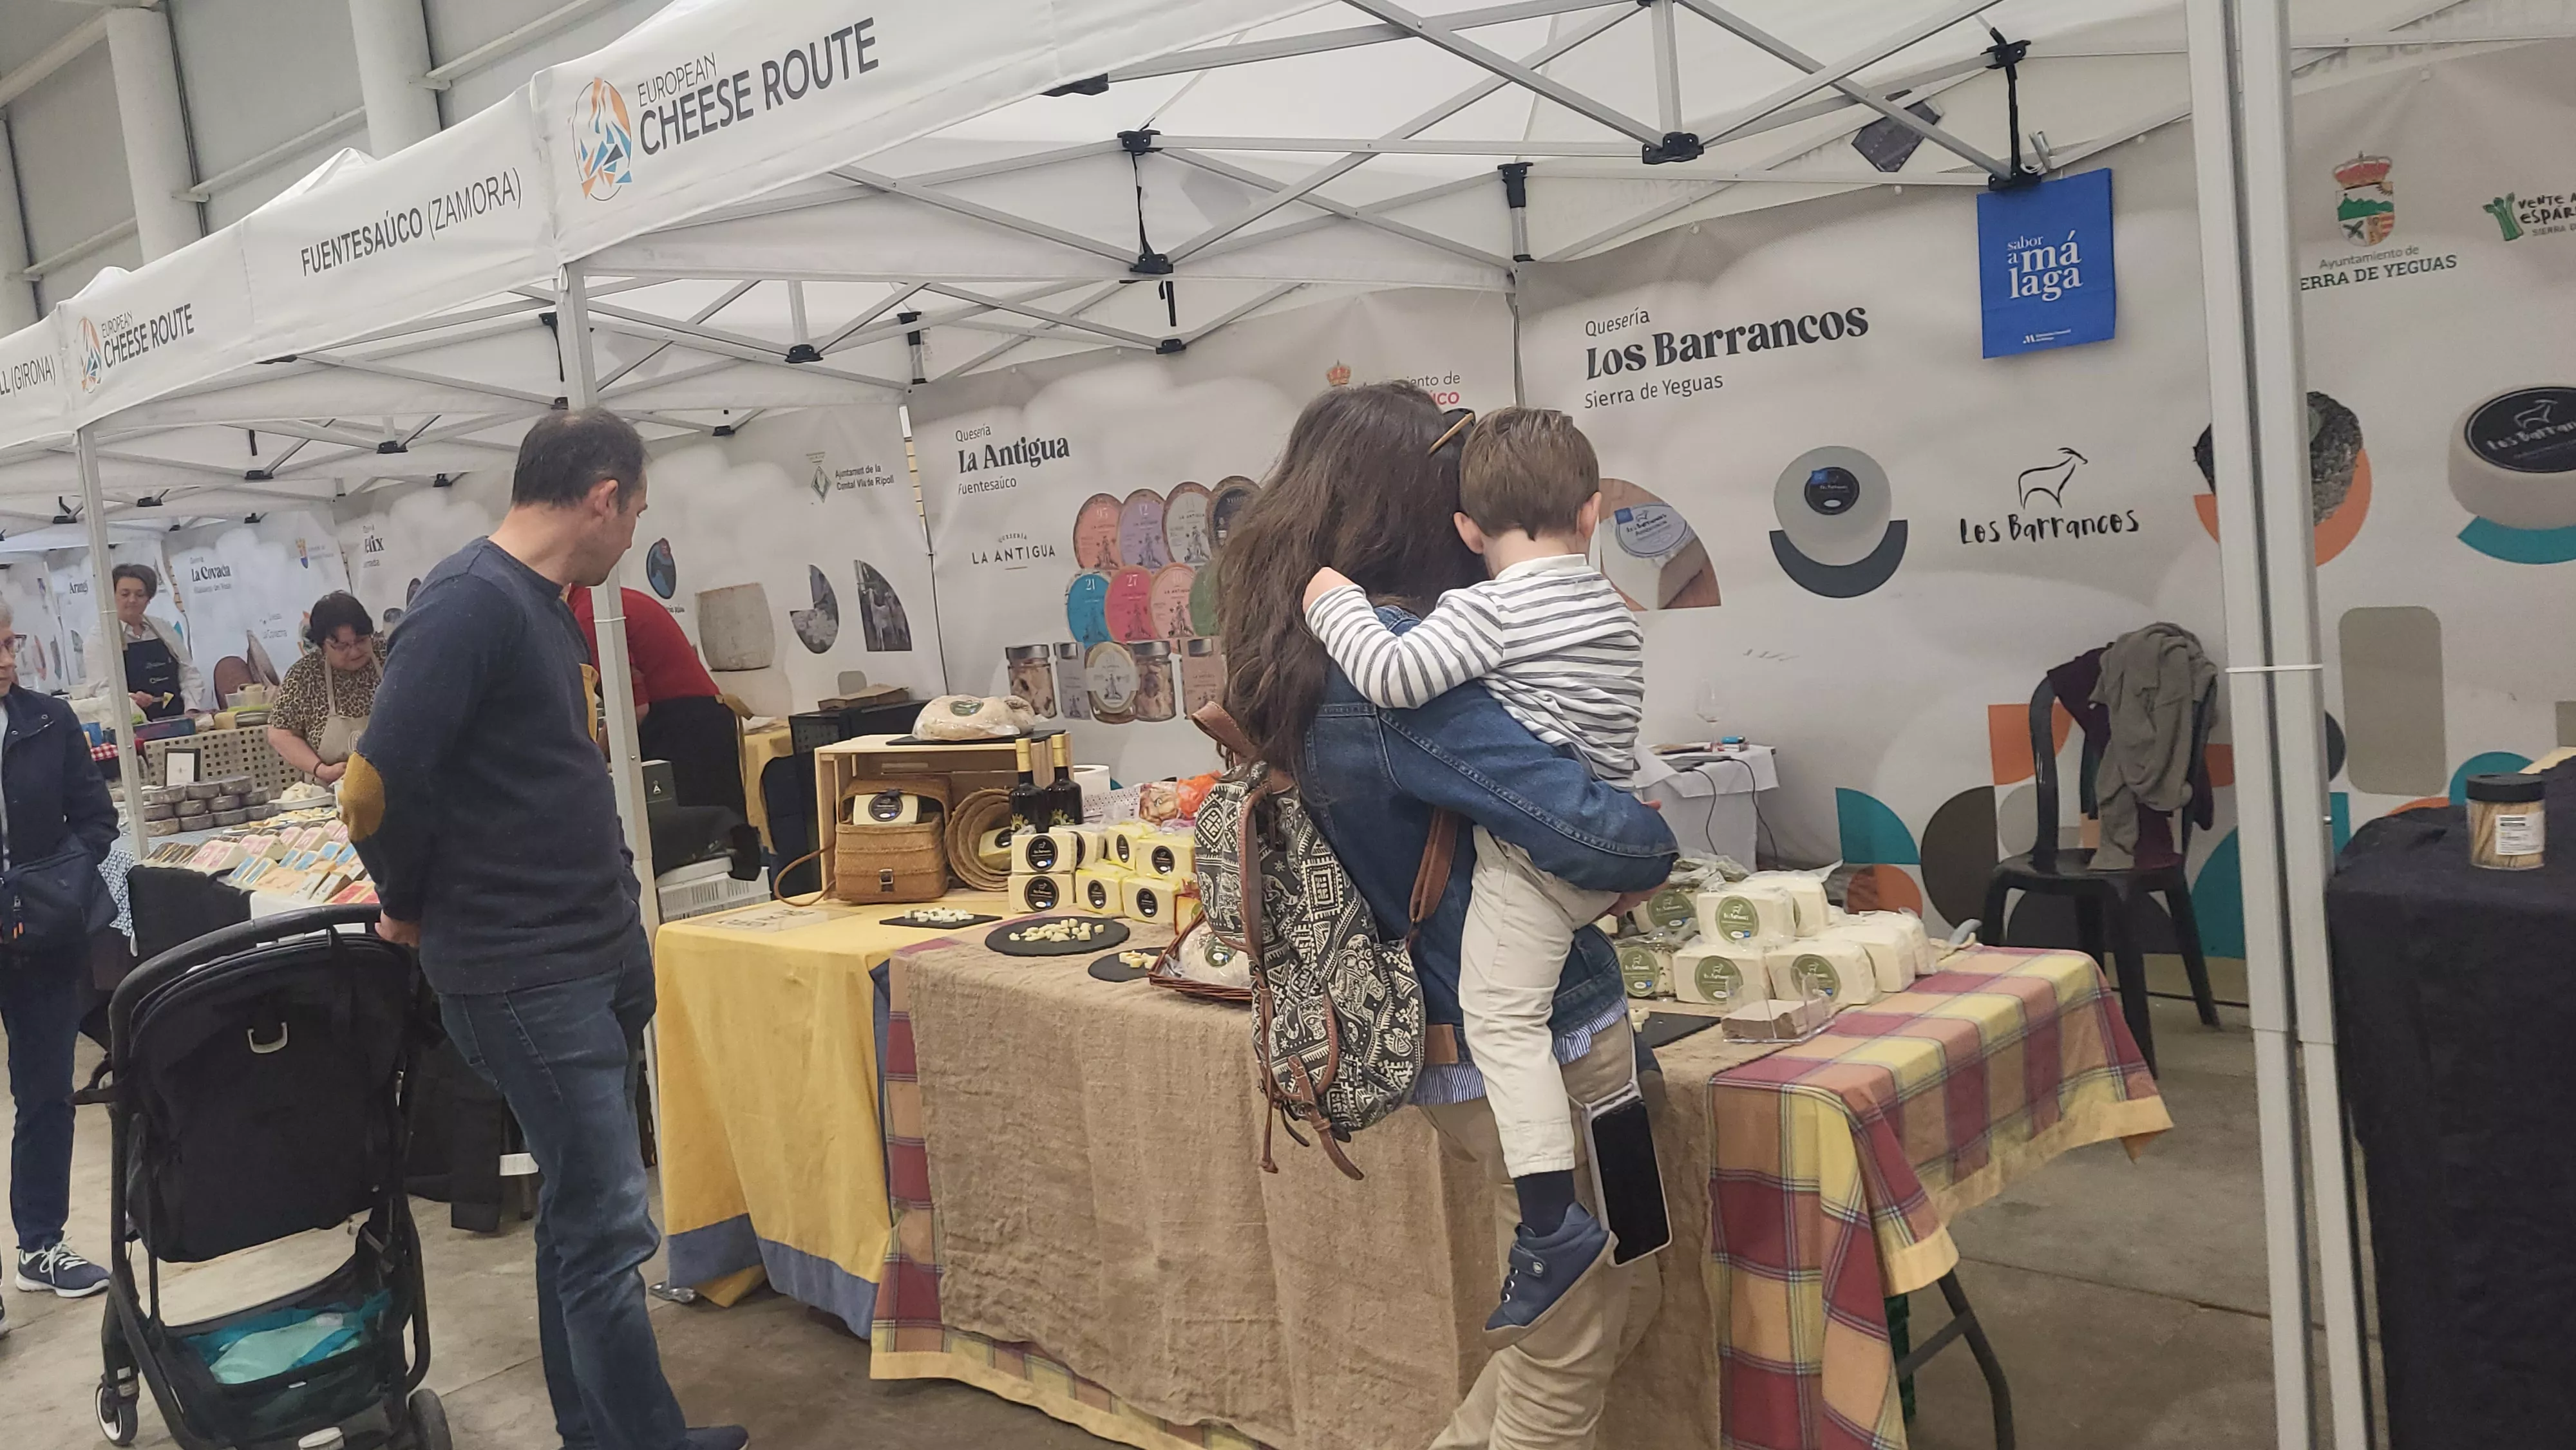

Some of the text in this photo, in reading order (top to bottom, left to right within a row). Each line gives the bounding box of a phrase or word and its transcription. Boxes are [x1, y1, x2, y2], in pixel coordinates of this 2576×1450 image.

[638, 52, 717, 108] EUROPEAN
[640, 17, 879, 155] CHEESE ROUTE
[301, 167, 522, 277] FUENTESAÚCO (ZAMORA)
[2007, 236, 2044, 250] sabor
[2007, 229, 2083, 274] a má
[2319, 245, 2420, 270] Ayuntamiento de
[2009, 267, 2084, 302] laga
[2300, 254, 2458, 291] ERRA DE YEGUAS
[100, 310, 133, 339] EUROPEAN
[104, 303, 194, 368] CHEESE ROUTE
[1585, 307, 1651, 337] Quesería
[1586, 306, 1870, 381] Los Barrancos
[11, 353, 56, 398] (GIRONA)
[1443, 370, 1461, 385] de
[1584, 373, 1724, 410] Sierra de Yeguas
[955, 423, 992, 442] Quesería
[958, 436, 1070, 474] La Antigua
[875, 475, 895, 487] Ripoll
[958, 475, 1018, 495] Fuentesaúco
[1960, 509, 2141, 545] Los Barrancos
[972, 544, 1056, 565] LA ANTIGUA
[1085, 578, 1095, 591] 21
[1126, 574, 1139, 587] 27
